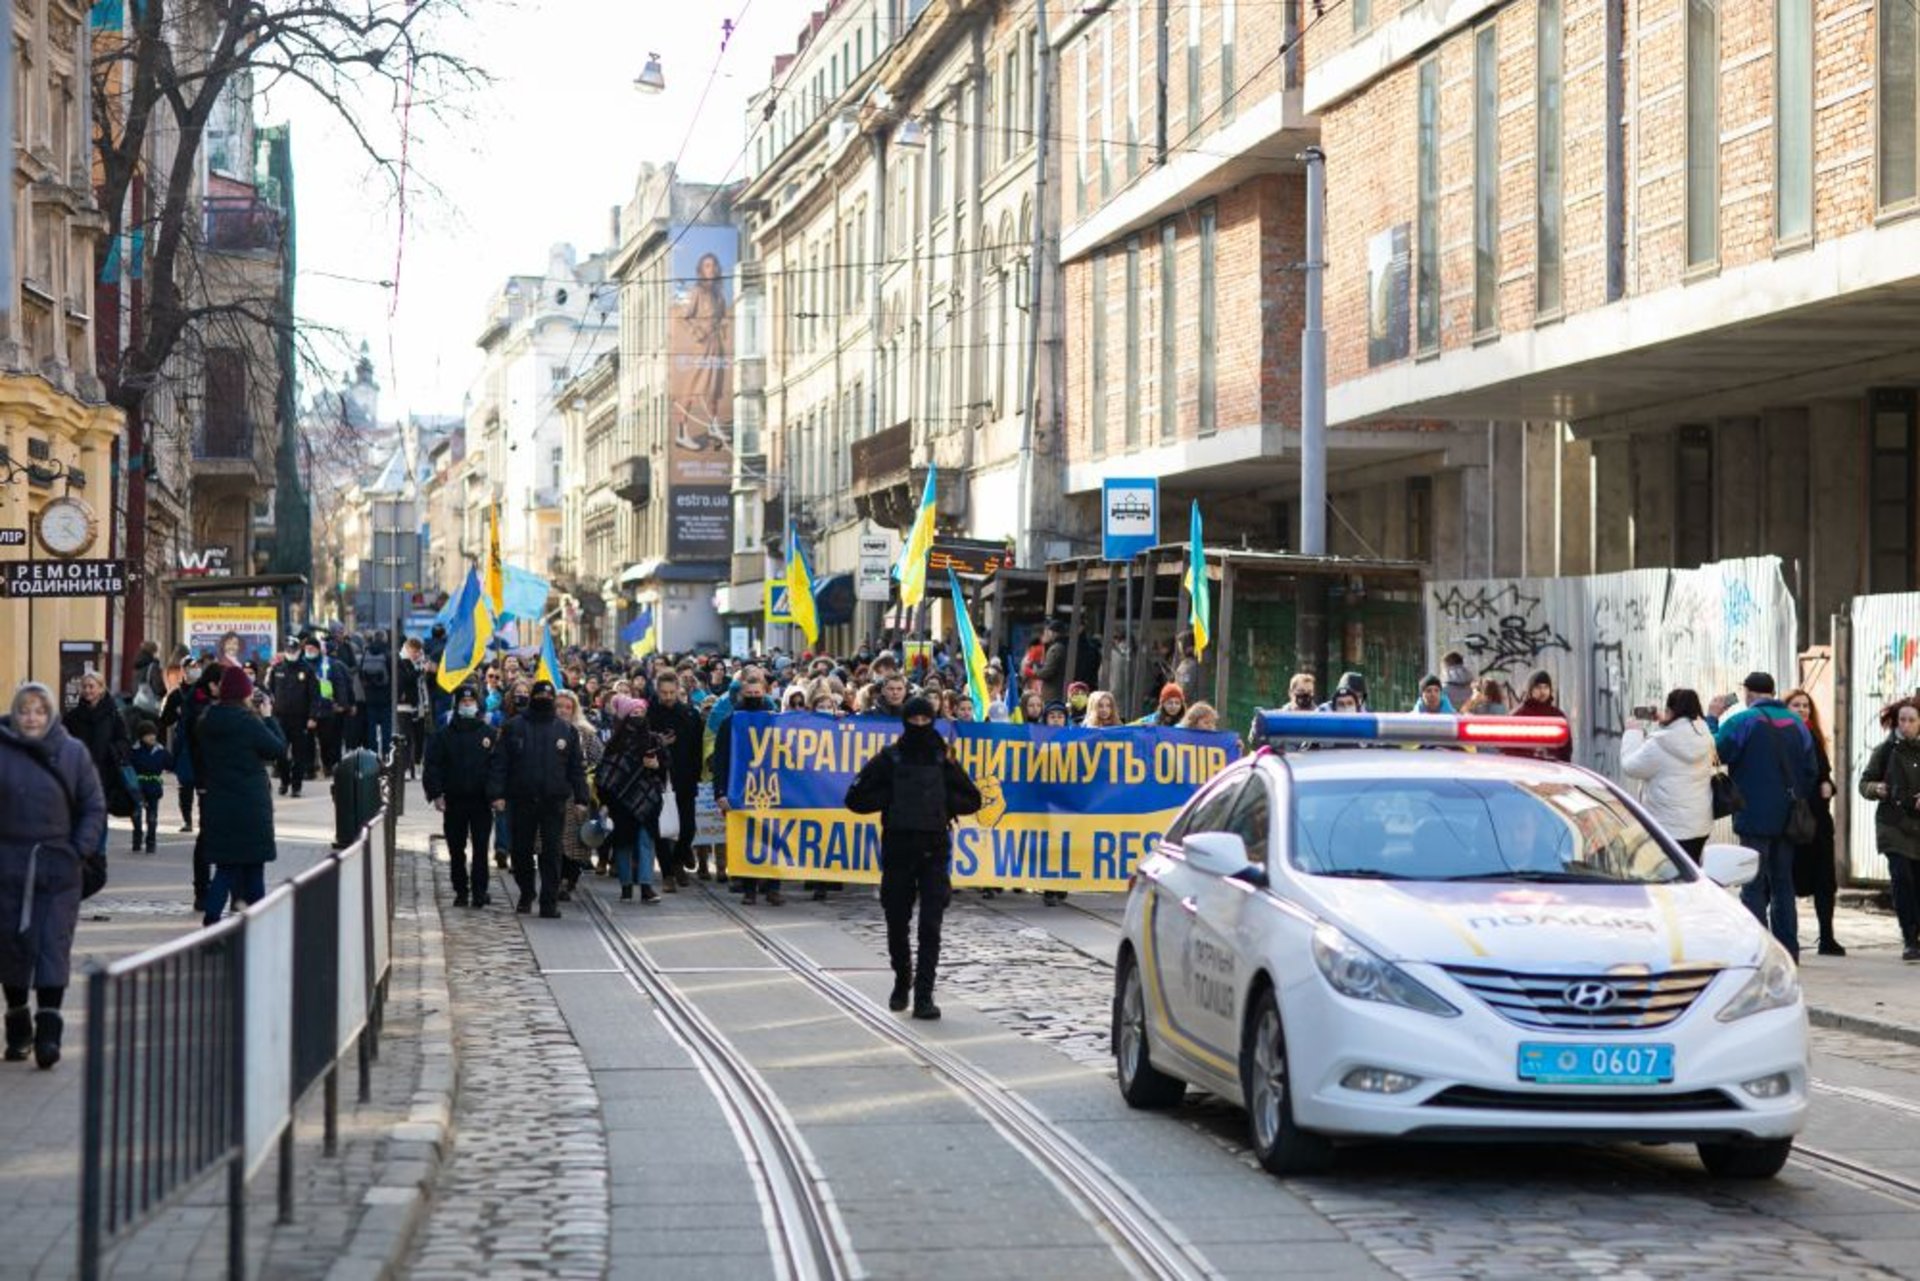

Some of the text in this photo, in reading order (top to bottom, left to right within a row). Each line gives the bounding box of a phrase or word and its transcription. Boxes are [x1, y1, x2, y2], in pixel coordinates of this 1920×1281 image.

[677, 492, 728, 507] estro.ua
[17, 564, 116, 579] РЕМОНТ
[11, 578, 122, 593] ГОДИННИКІВ
[748, 724, 898, 773] УКРАЇН
[1155, 741, 1226, 784] ОПІР
[745, 816, 979, 877] UKRAINS
[991, 828, 1081, 880] WILL
[1592, 1048, 1657, 1075] 0607
